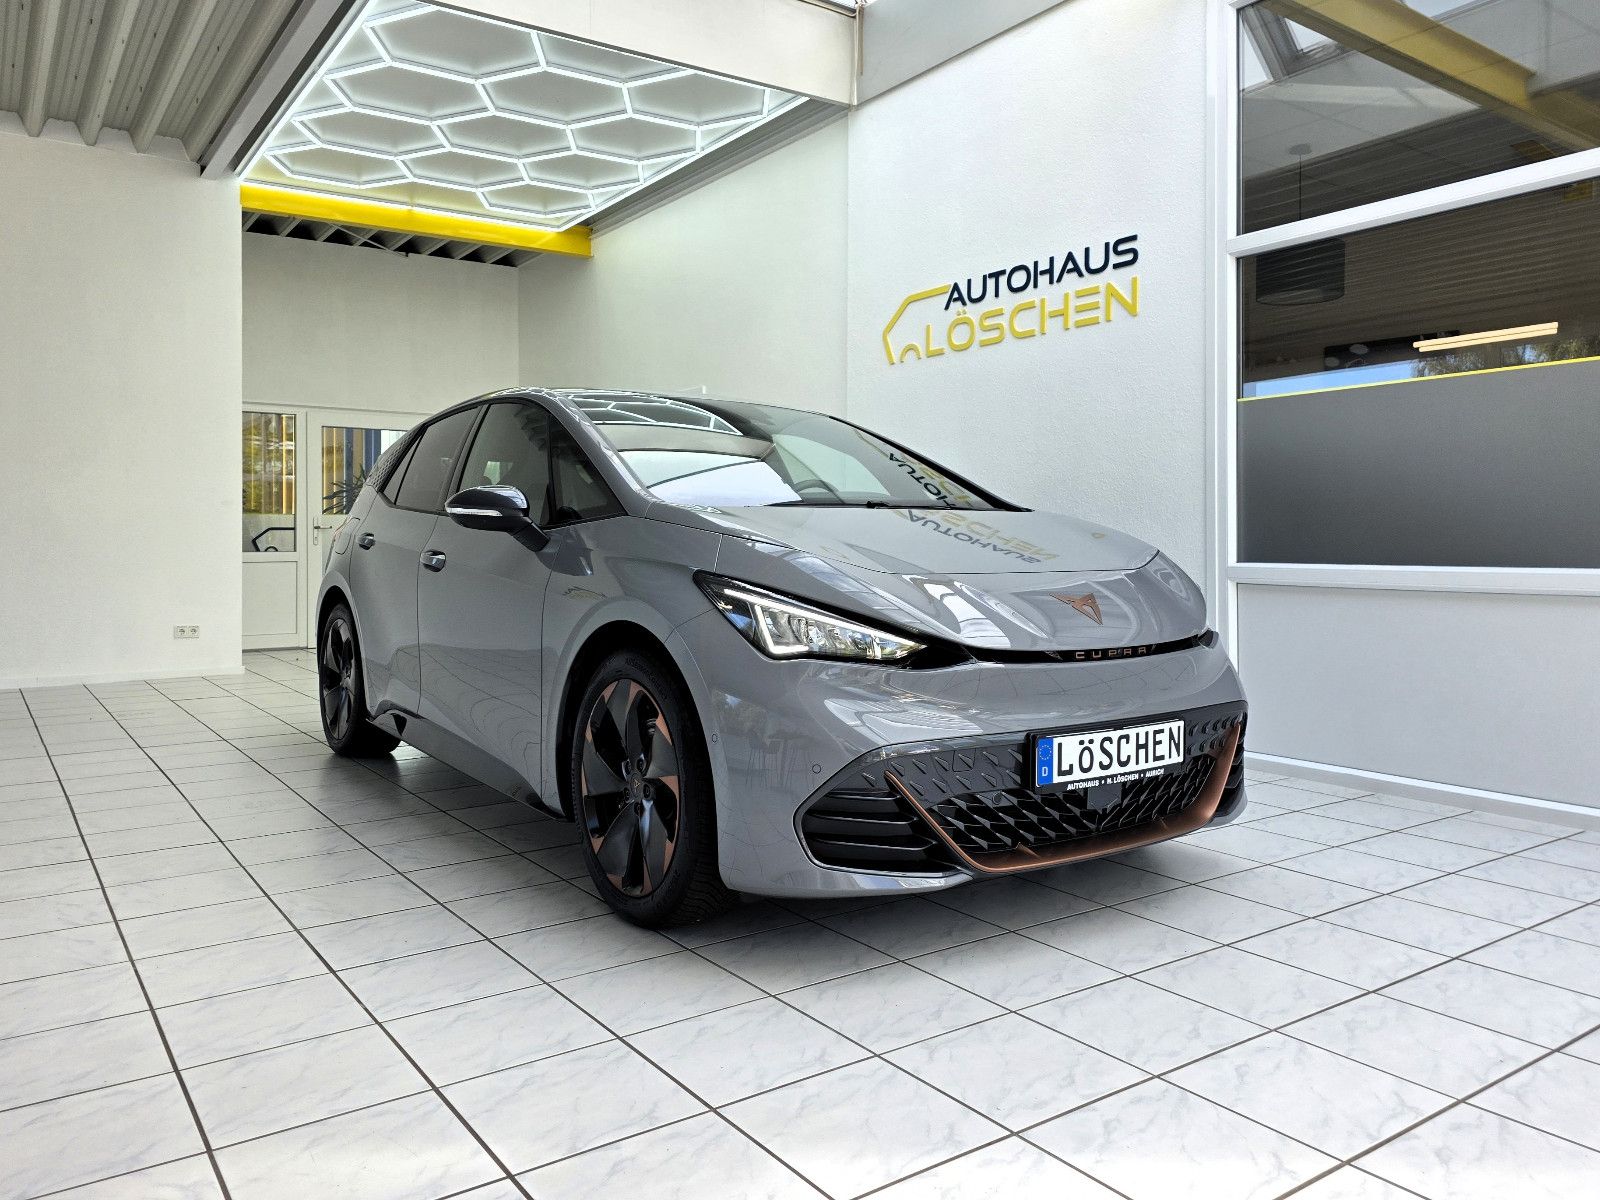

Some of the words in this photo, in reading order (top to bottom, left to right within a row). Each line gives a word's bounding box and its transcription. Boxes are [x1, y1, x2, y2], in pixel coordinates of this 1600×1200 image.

[944, 234, 1139, 310] AUTOHAUS
[925, 275, 1139, 358] LÖSCHEN
[1075, 646, 1147, 659] CUPRA
[1041, 766, 1049, 777] D
[1057, 725, 1182, 777] LÖSCHEN
[1066, 779, 1100, 791] AUTOHAUS
[1113, 773, 1139, 784] LÖSCHEN
